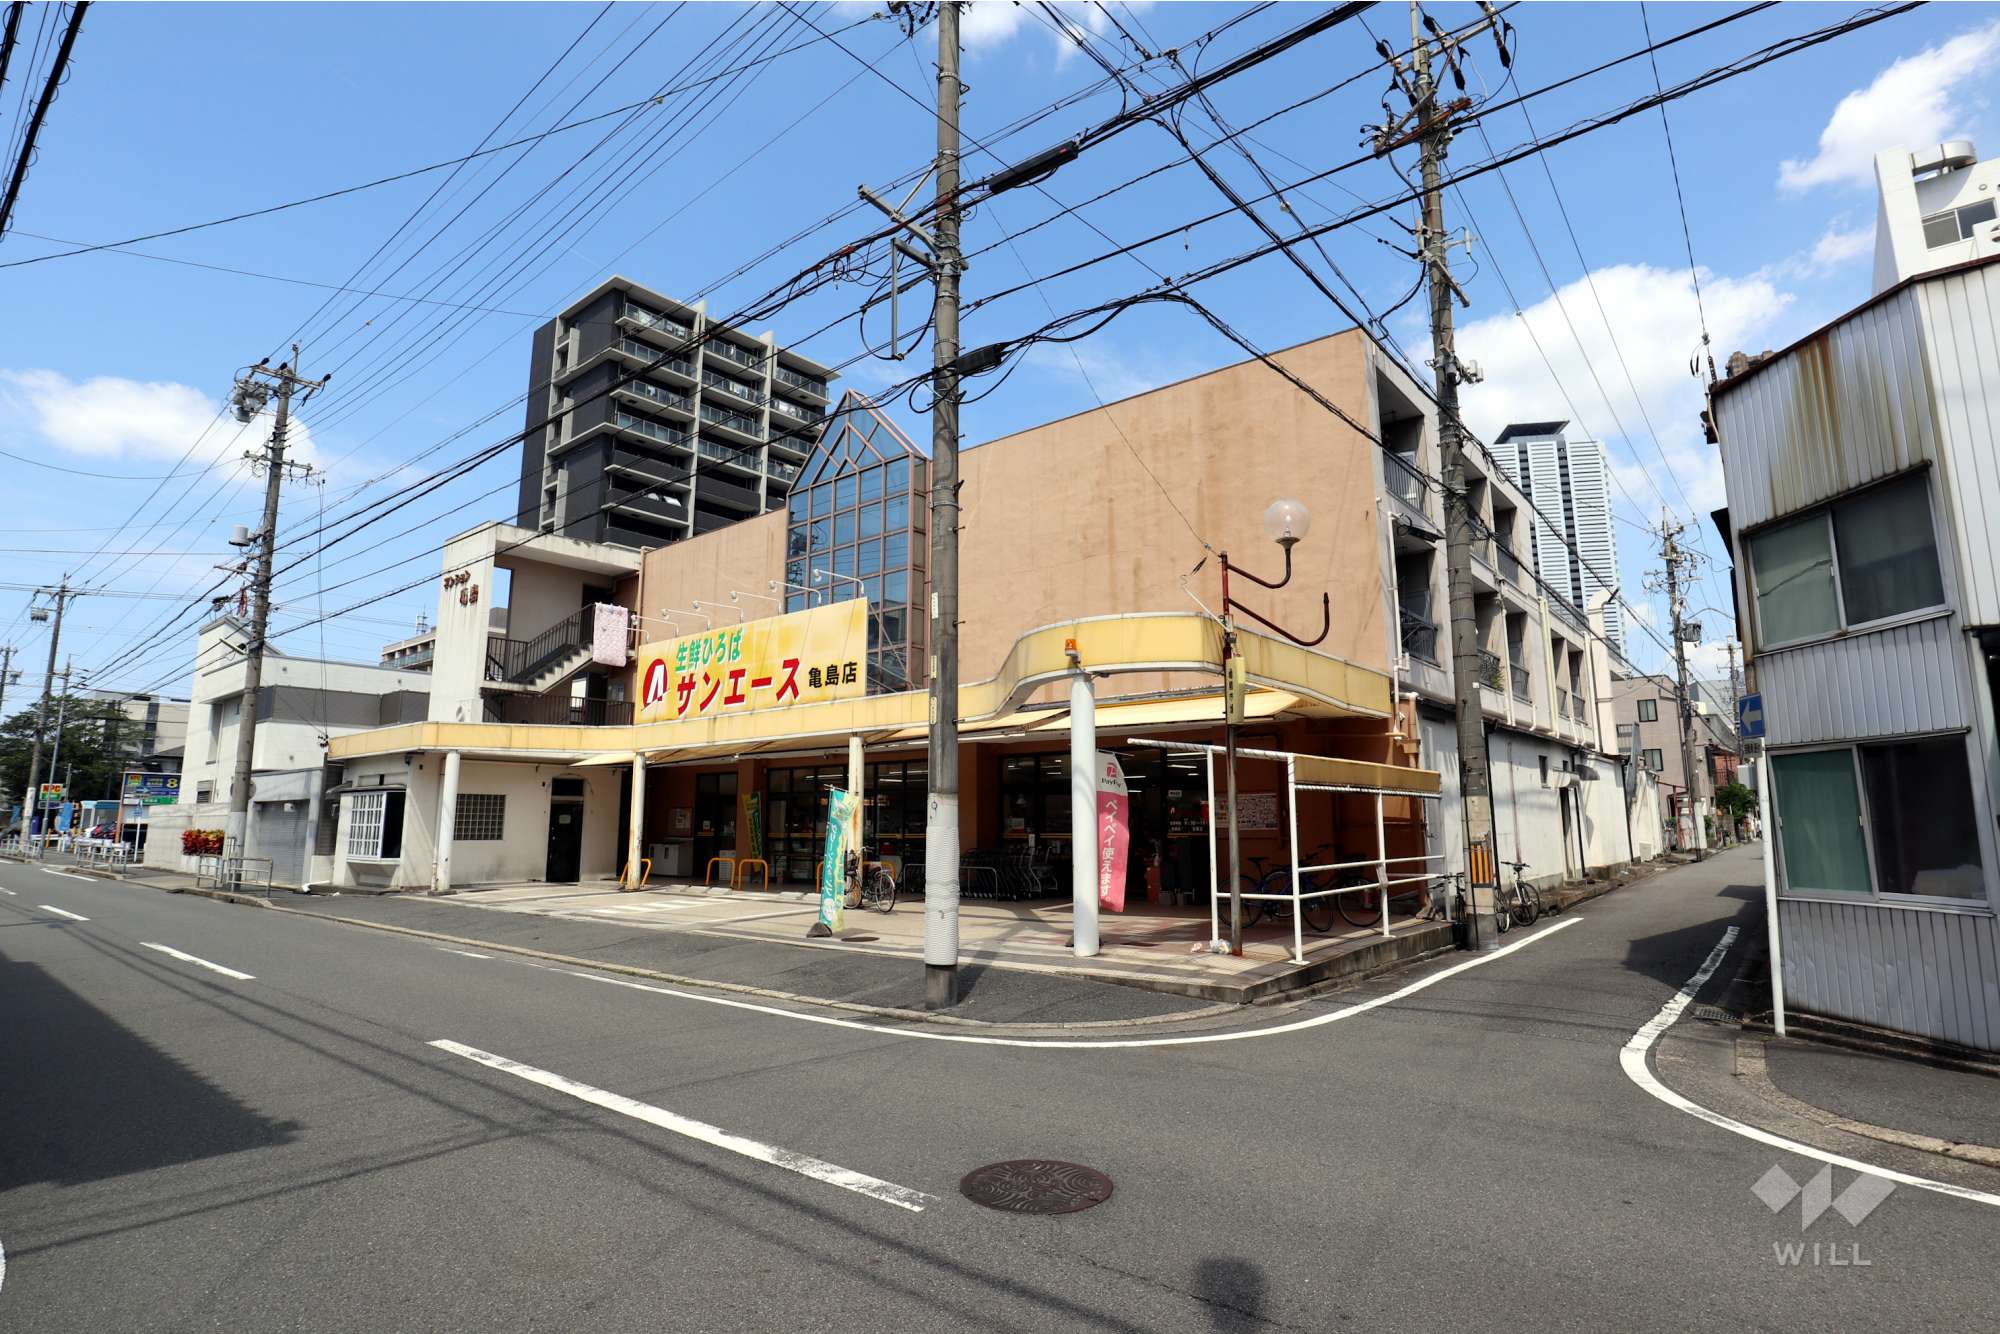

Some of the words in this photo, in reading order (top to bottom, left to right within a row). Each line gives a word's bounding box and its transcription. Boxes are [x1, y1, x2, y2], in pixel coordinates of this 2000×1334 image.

[675, 627, 744, 672] 生鮮ひろば
[677, 657, 800, 716] サンエース
[808, 661, 859, 689] 亀島店
